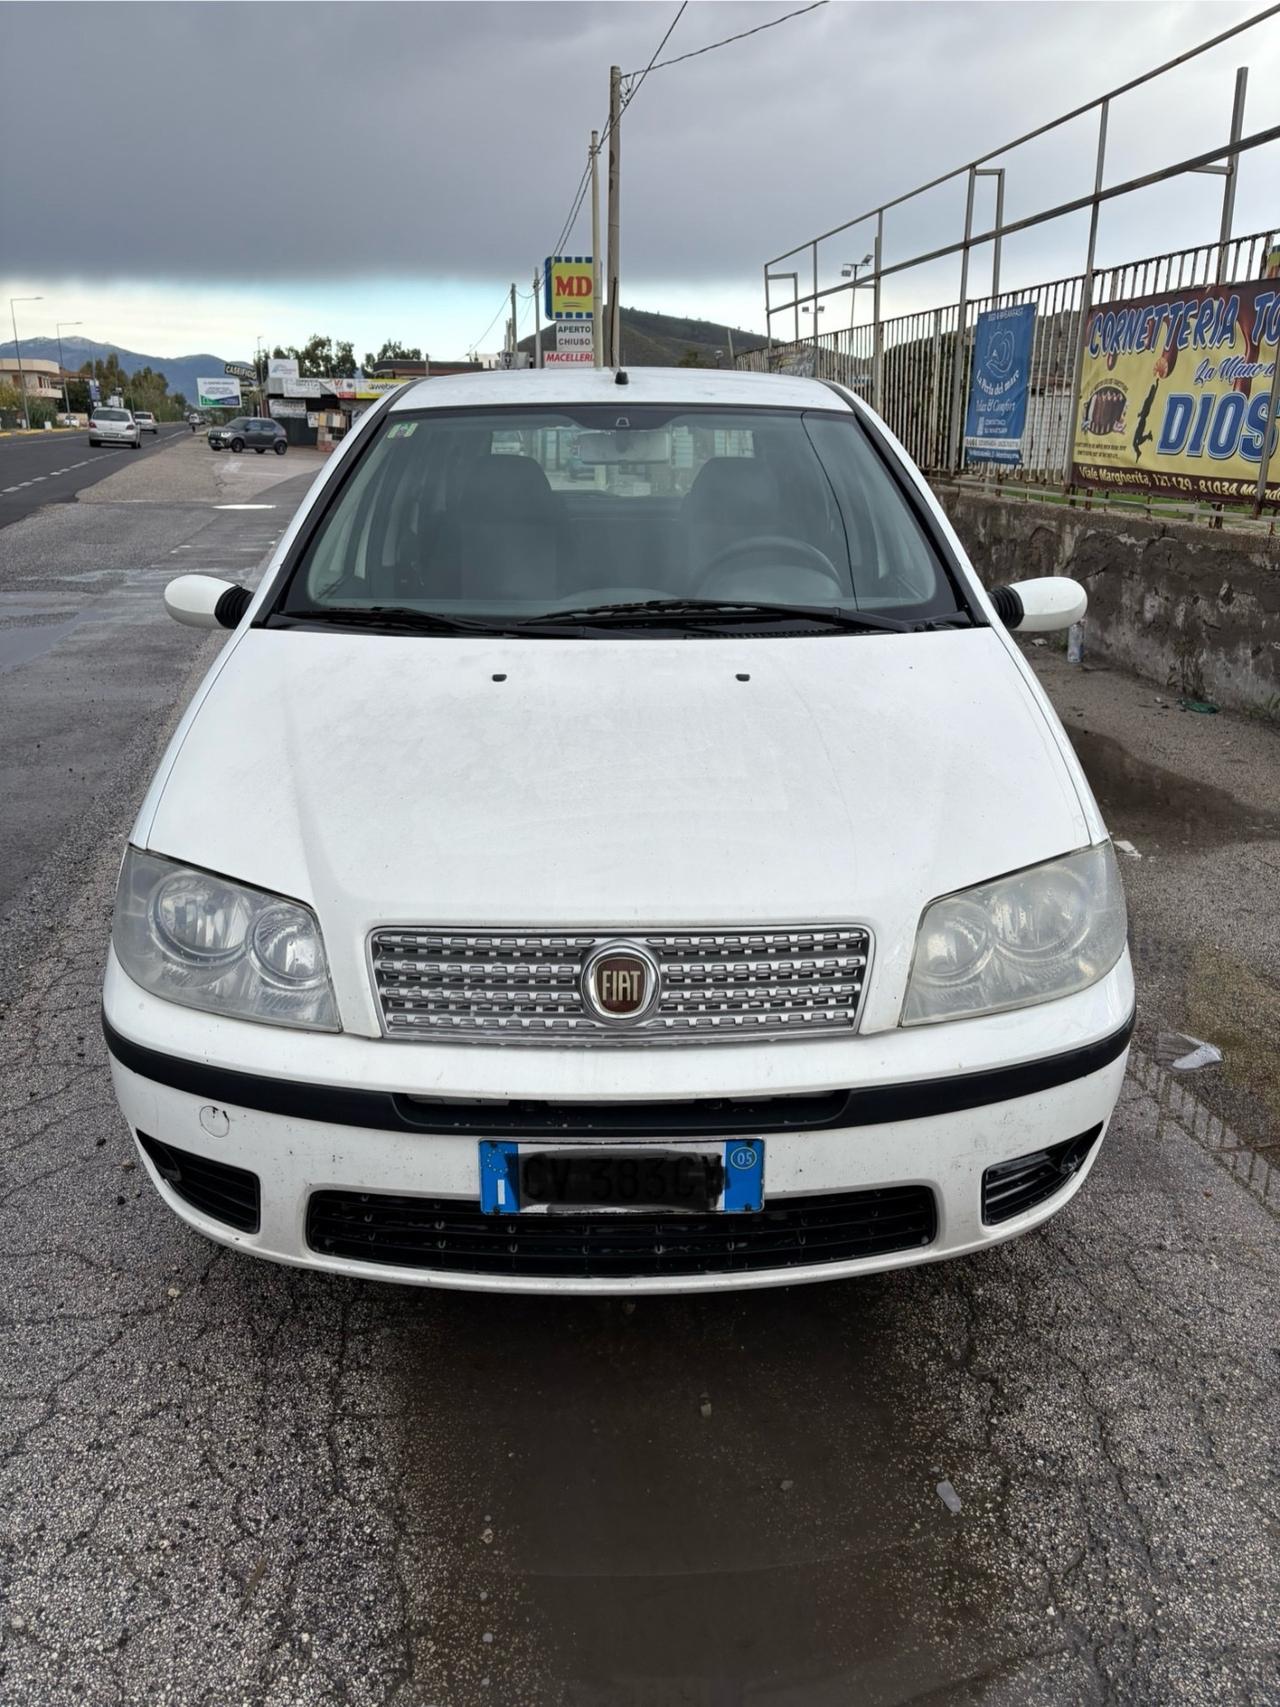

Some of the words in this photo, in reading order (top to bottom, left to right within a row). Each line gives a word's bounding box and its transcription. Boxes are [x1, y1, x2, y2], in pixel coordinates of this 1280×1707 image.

[555, 276, 593, 297] MD
[558, 325, 592, 334] APERTO
[1089, 295, 1240, 358] CORNETTERIA
[558, 337, 591, 346] CHIUSO
[546, 353, 593, 363] MACELLERI
[225, 365, 257, 380] CASEIFICIO
[1194, 358, 1217, 387] La
[1079, 466, 1098, 480] Viale
[1100, 469, 1151, 487] Margherita,
[1200, 480, 1238, 496] 81034
[602, 970, 641, 1001] FIAT
[737, 1153, 752, 1166] 05
